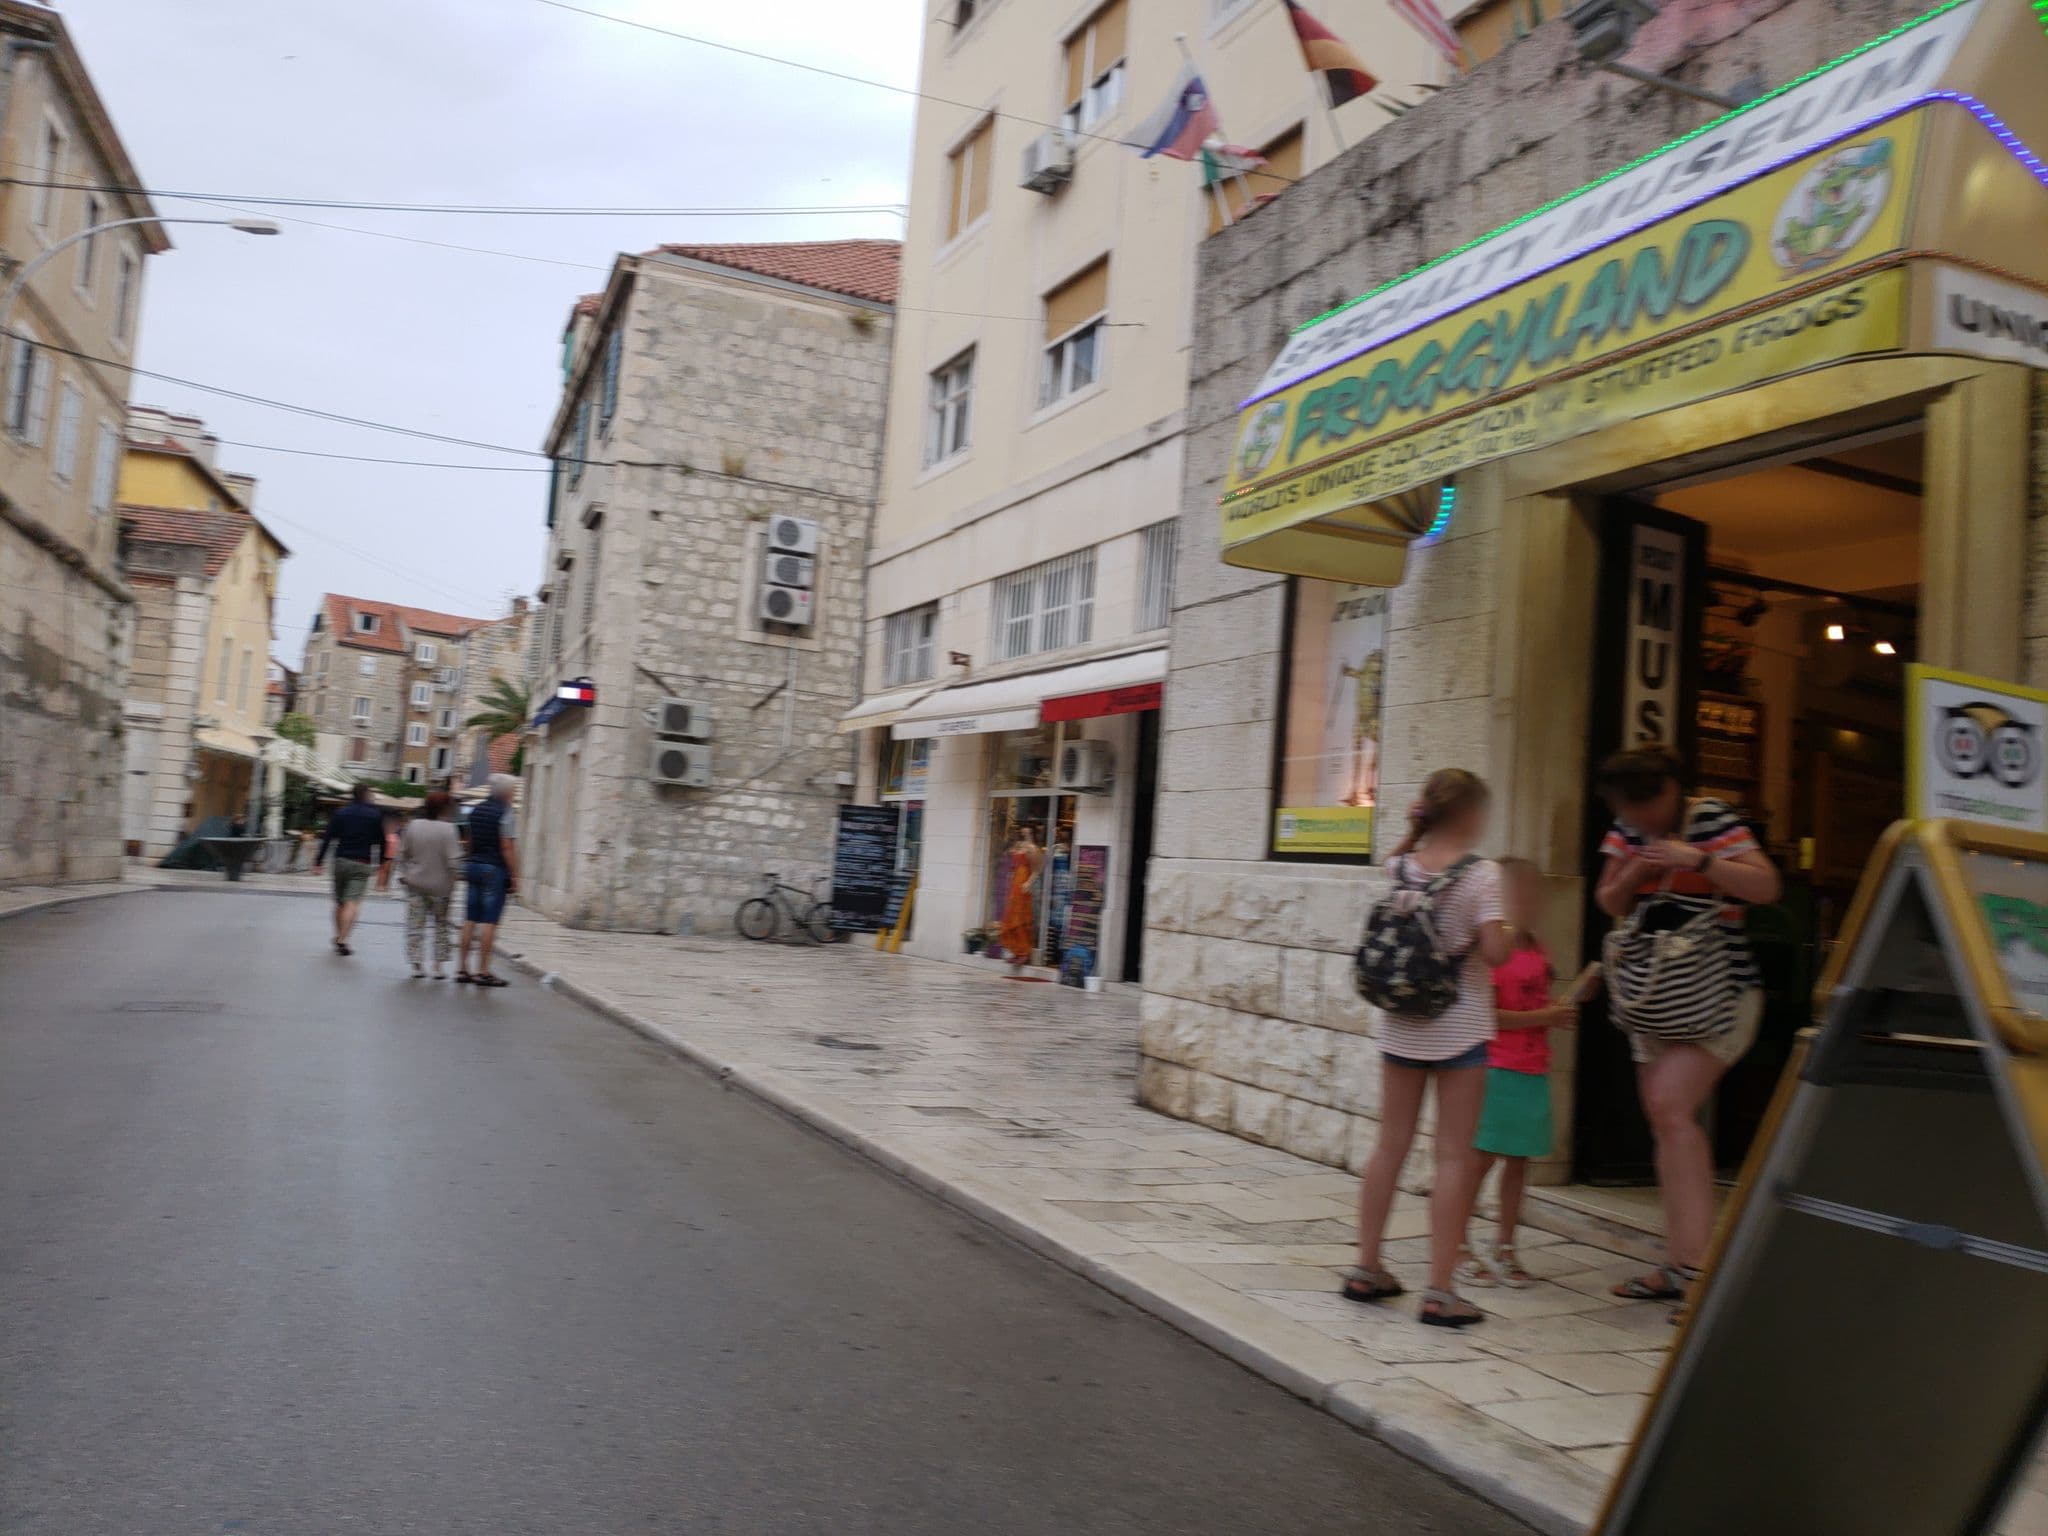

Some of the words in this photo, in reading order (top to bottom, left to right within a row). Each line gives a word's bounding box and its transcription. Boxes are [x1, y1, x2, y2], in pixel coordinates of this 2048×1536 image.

[1553, 34, 1946, 249] MUSEUM
[1286, 217, 1752, 465] FROGGYLAND
[1303, 453, 1378, 498] UNIQUE
[1383, 404, 1528, 467] COLLECTION
[1583, 336, 1721, 405] STUFFED
[1731, 286, 1867, 355] FROGS
[1947, 292, 2048, 356] UNI
